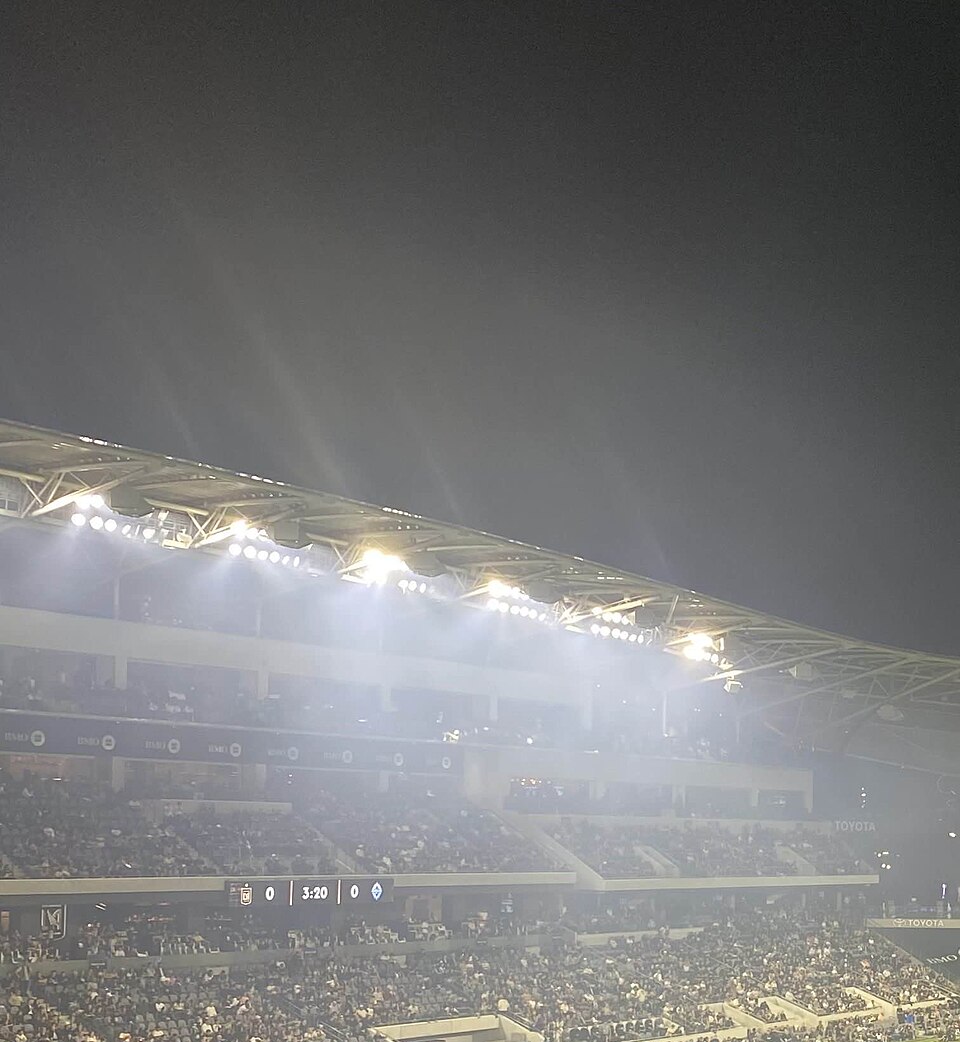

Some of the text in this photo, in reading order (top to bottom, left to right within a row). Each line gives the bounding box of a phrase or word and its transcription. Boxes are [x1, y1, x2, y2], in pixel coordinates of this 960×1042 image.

[835, 820, 876, 831] TOYOTA
[265, 884, 359, 900] 0 3:20 0
[908, 919, 944, 927] TOYOTA
